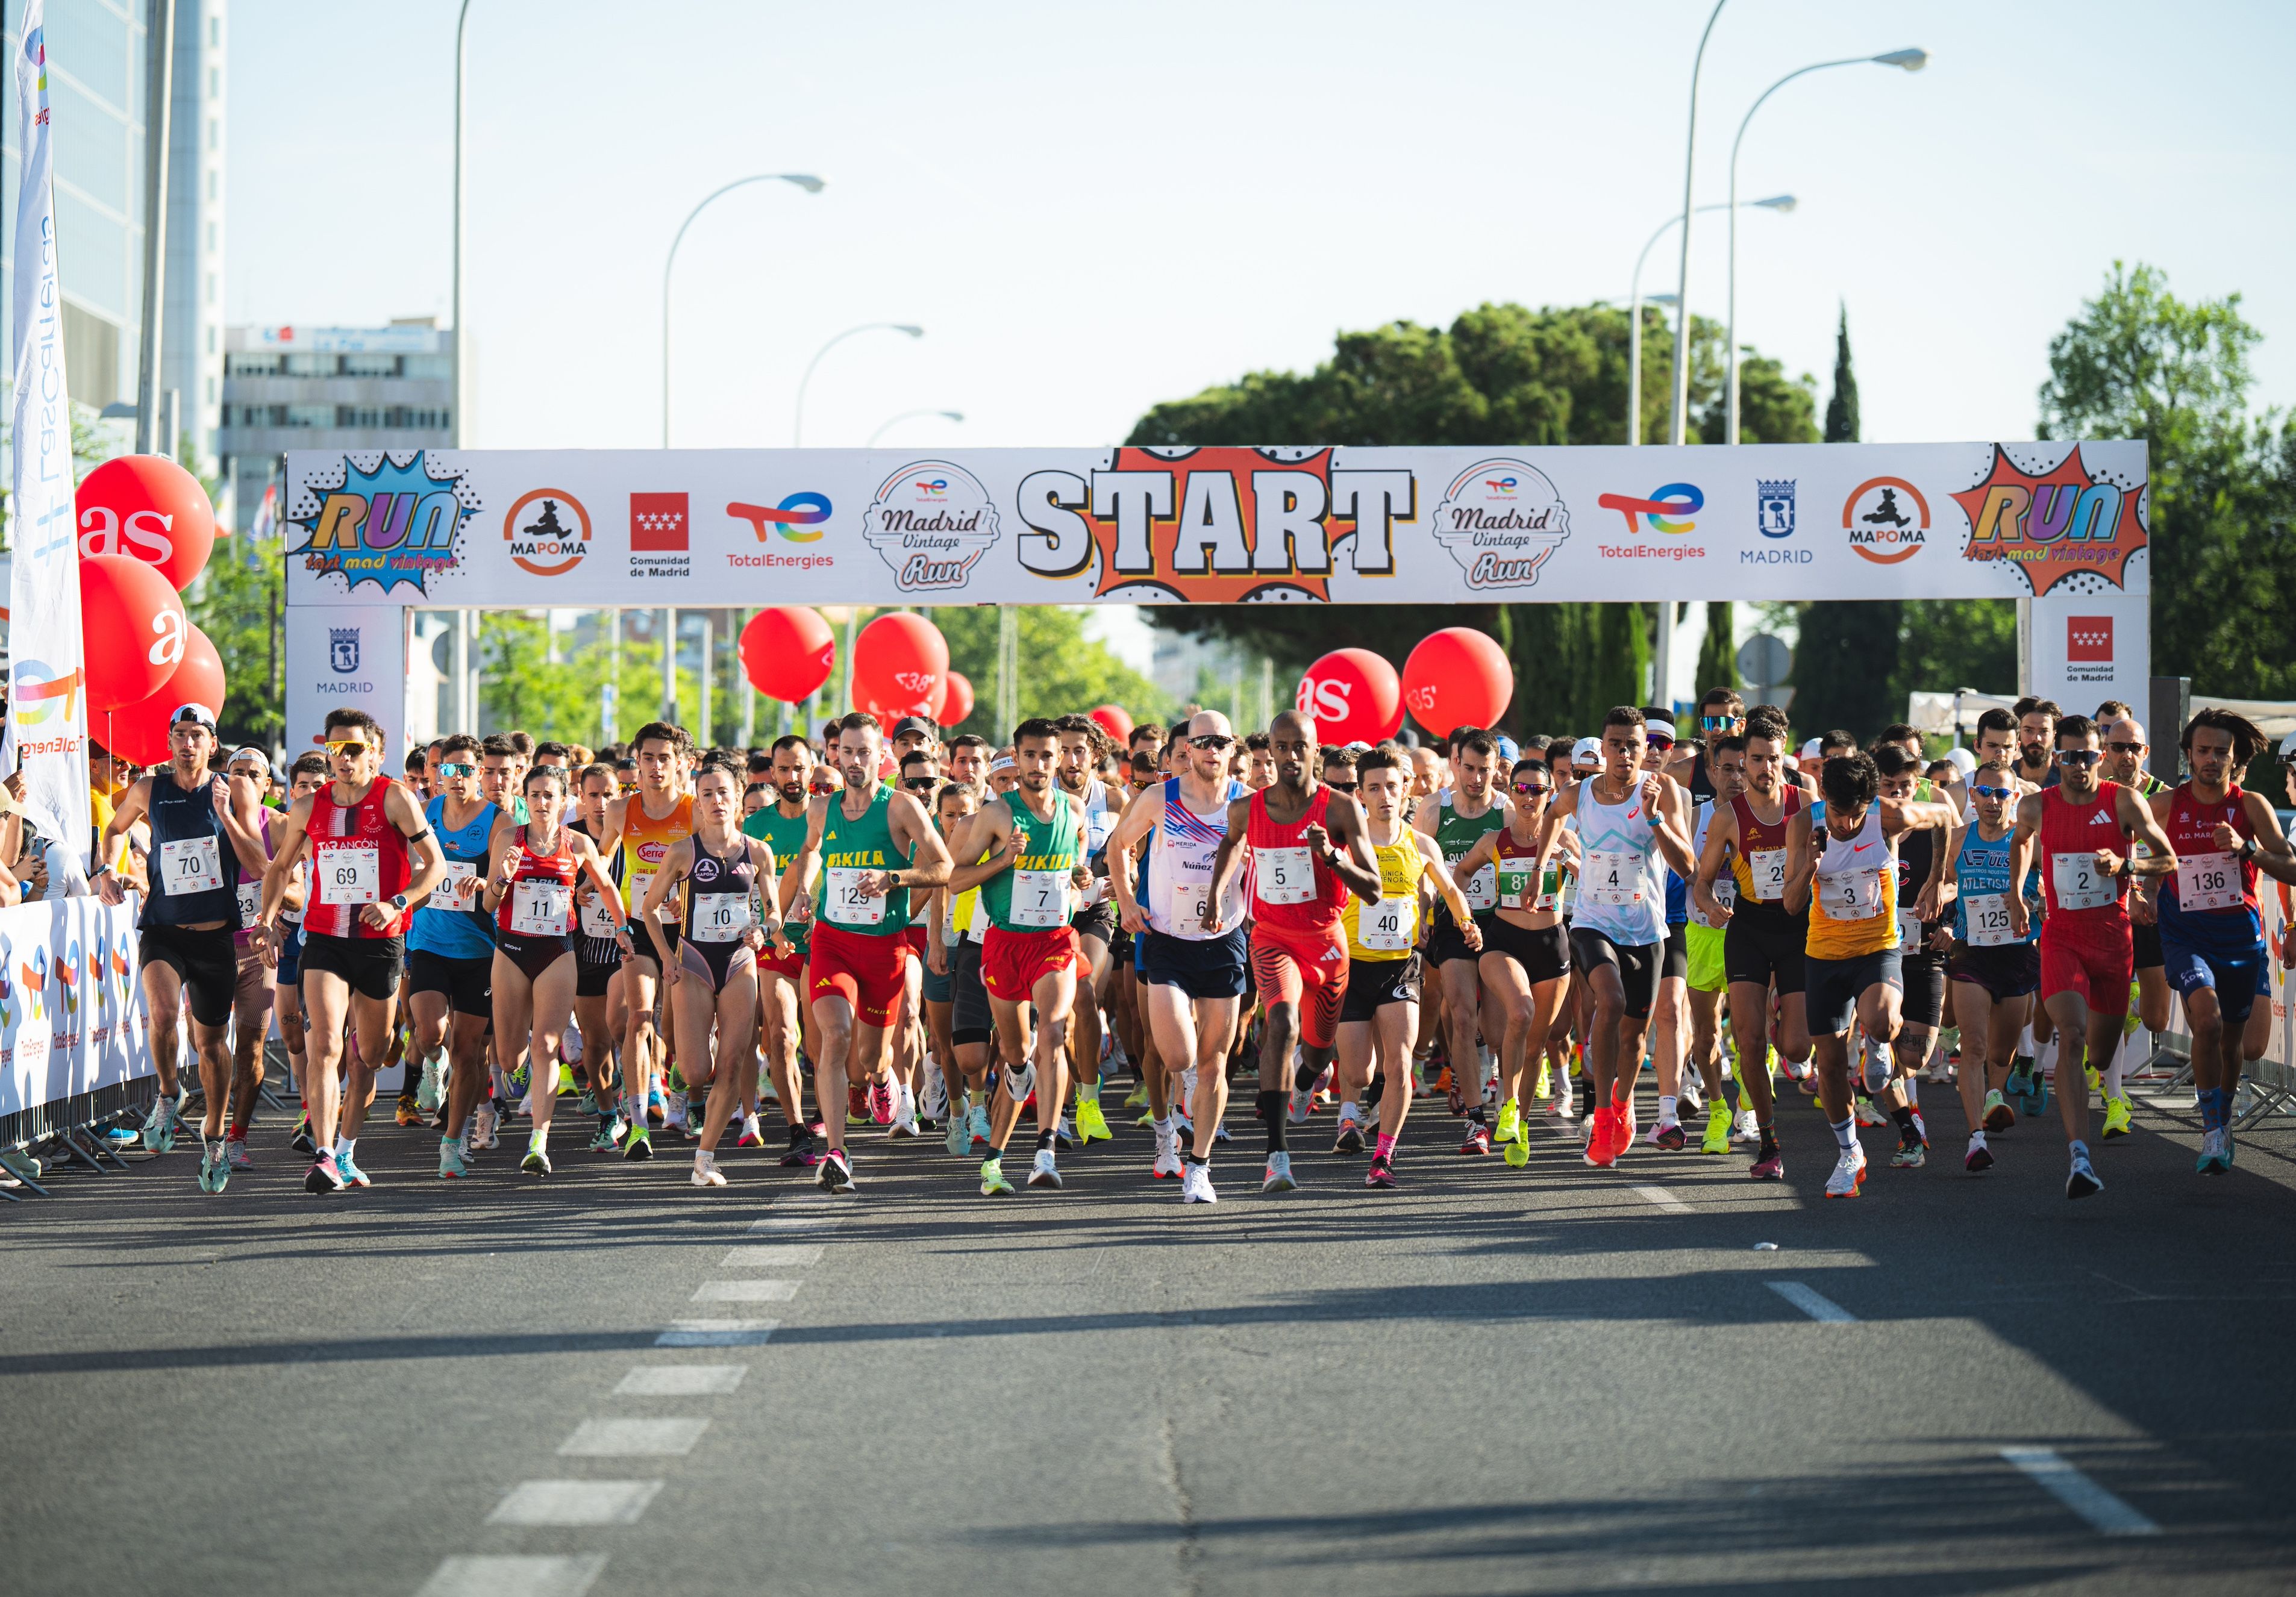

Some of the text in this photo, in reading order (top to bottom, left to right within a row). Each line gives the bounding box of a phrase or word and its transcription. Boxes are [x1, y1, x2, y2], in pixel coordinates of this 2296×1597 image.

[881, 510, 980, 532] Madrid
[1017, 469, 1417, 580] START
[1451, 508, 1551, 531] Madrid
[78, 506, 173, 566] as
[903, 533, 959, 551] Vintage
[1472, 532, 1530, 549] Vintage
[1849, 530, 1925, 543] MAPOMA
[510, 542, 587, 555] MAPOMA
[1598, 545, 1705, 561] TotalEnergies
[1741, 550, 1813, 564] MADRID
[1966, 544, 2121, 566] fast mad vintage
[305, 553, 459, 574] fast mad vintage
[630, 557, 690, 565] Comunidad
[727, 554, 834, 570] TotalEnergies
[903, 554, 962, 585] Run
[1472, 551, 1533, 583] Run
[630, 568, 690, 577] de Madrid
[149, 605, 187, 666] a
[317, 682, 374, 693] MADRID
[1295, 677, 1352, 722] as
[317, 838, 379, 850] TARANCÓN
[641, 847, 666, 858] Serra
[178, 856, 200, 875] 70
[1182, 861, 1212, 871] Núñez
[336, 867, 357, 884] 69
[1275, 867, 1286, 884] 5
[1608, 870, 1619, 886] 4
[2078, 872, 2089, 890] 2
[2192, 871, 2226, 891] 136
[1466, 879, 1481, 893] 3
[839, 886, 869, 904] 129
[1038, 890, 1049, 907] 7
[1844, 888, 1856, 904] 3
[531, 899, 548, 917] 11
[713, 908, 731, 925] 10
[1196, 901, 1207, 916] 6
[1378, 915, 1398, 931] 40
[1979, 910, 2009, 928] 125
[2184, 972, 2205, 987] ADM
